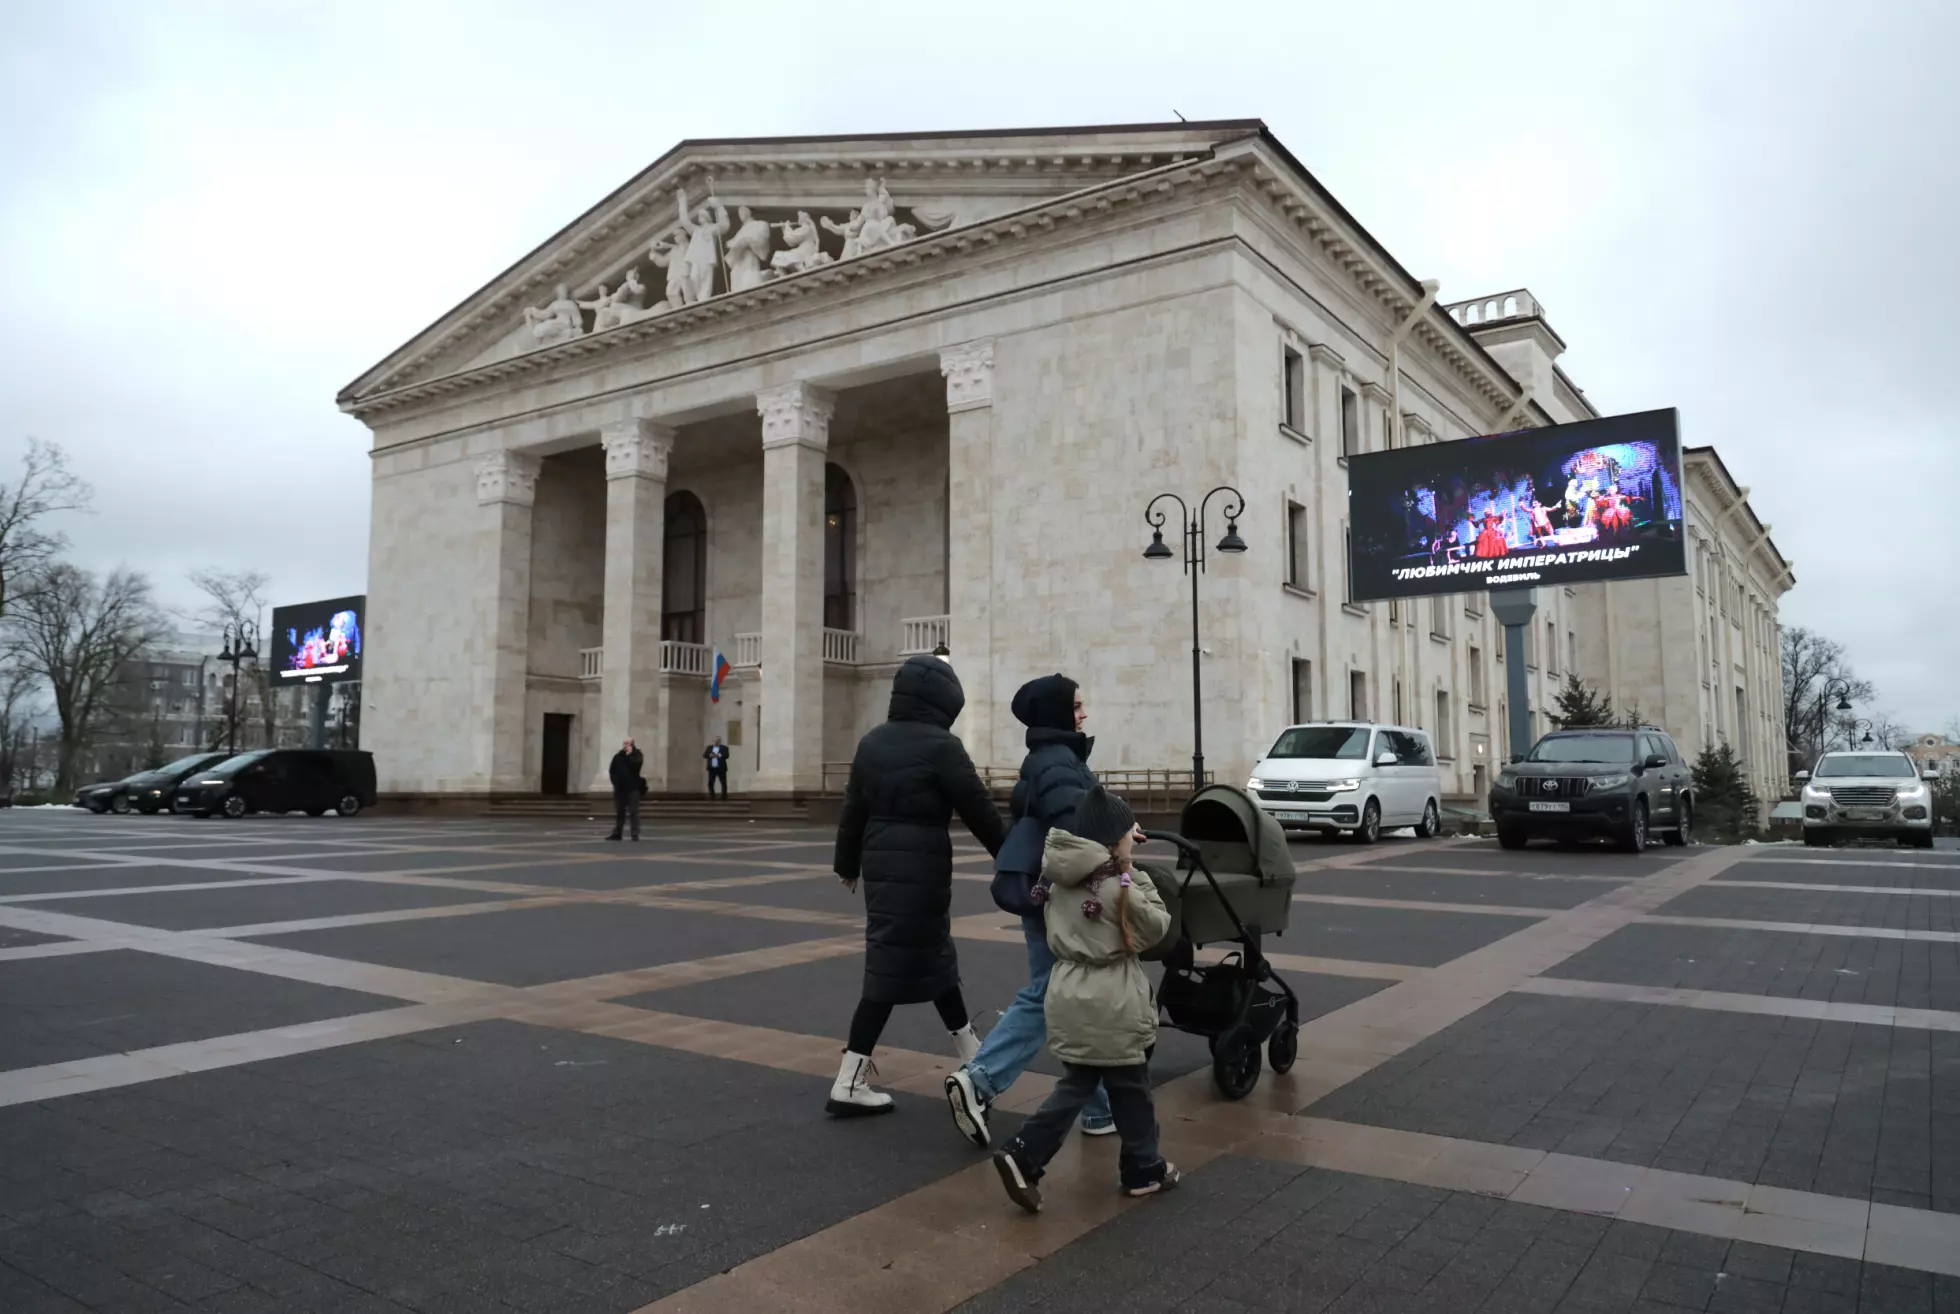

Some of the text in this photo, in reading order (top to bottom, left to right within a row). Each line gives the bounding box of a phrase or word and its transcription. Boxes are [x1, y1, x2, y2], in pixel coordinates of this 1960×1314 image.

[1392, 545, 1640, 580] "ЛЮБИМЧИК ИМПЕРАТРИЦЫ"
[1486, 572, 1541, 584] ВОДЕВИЛЬ
